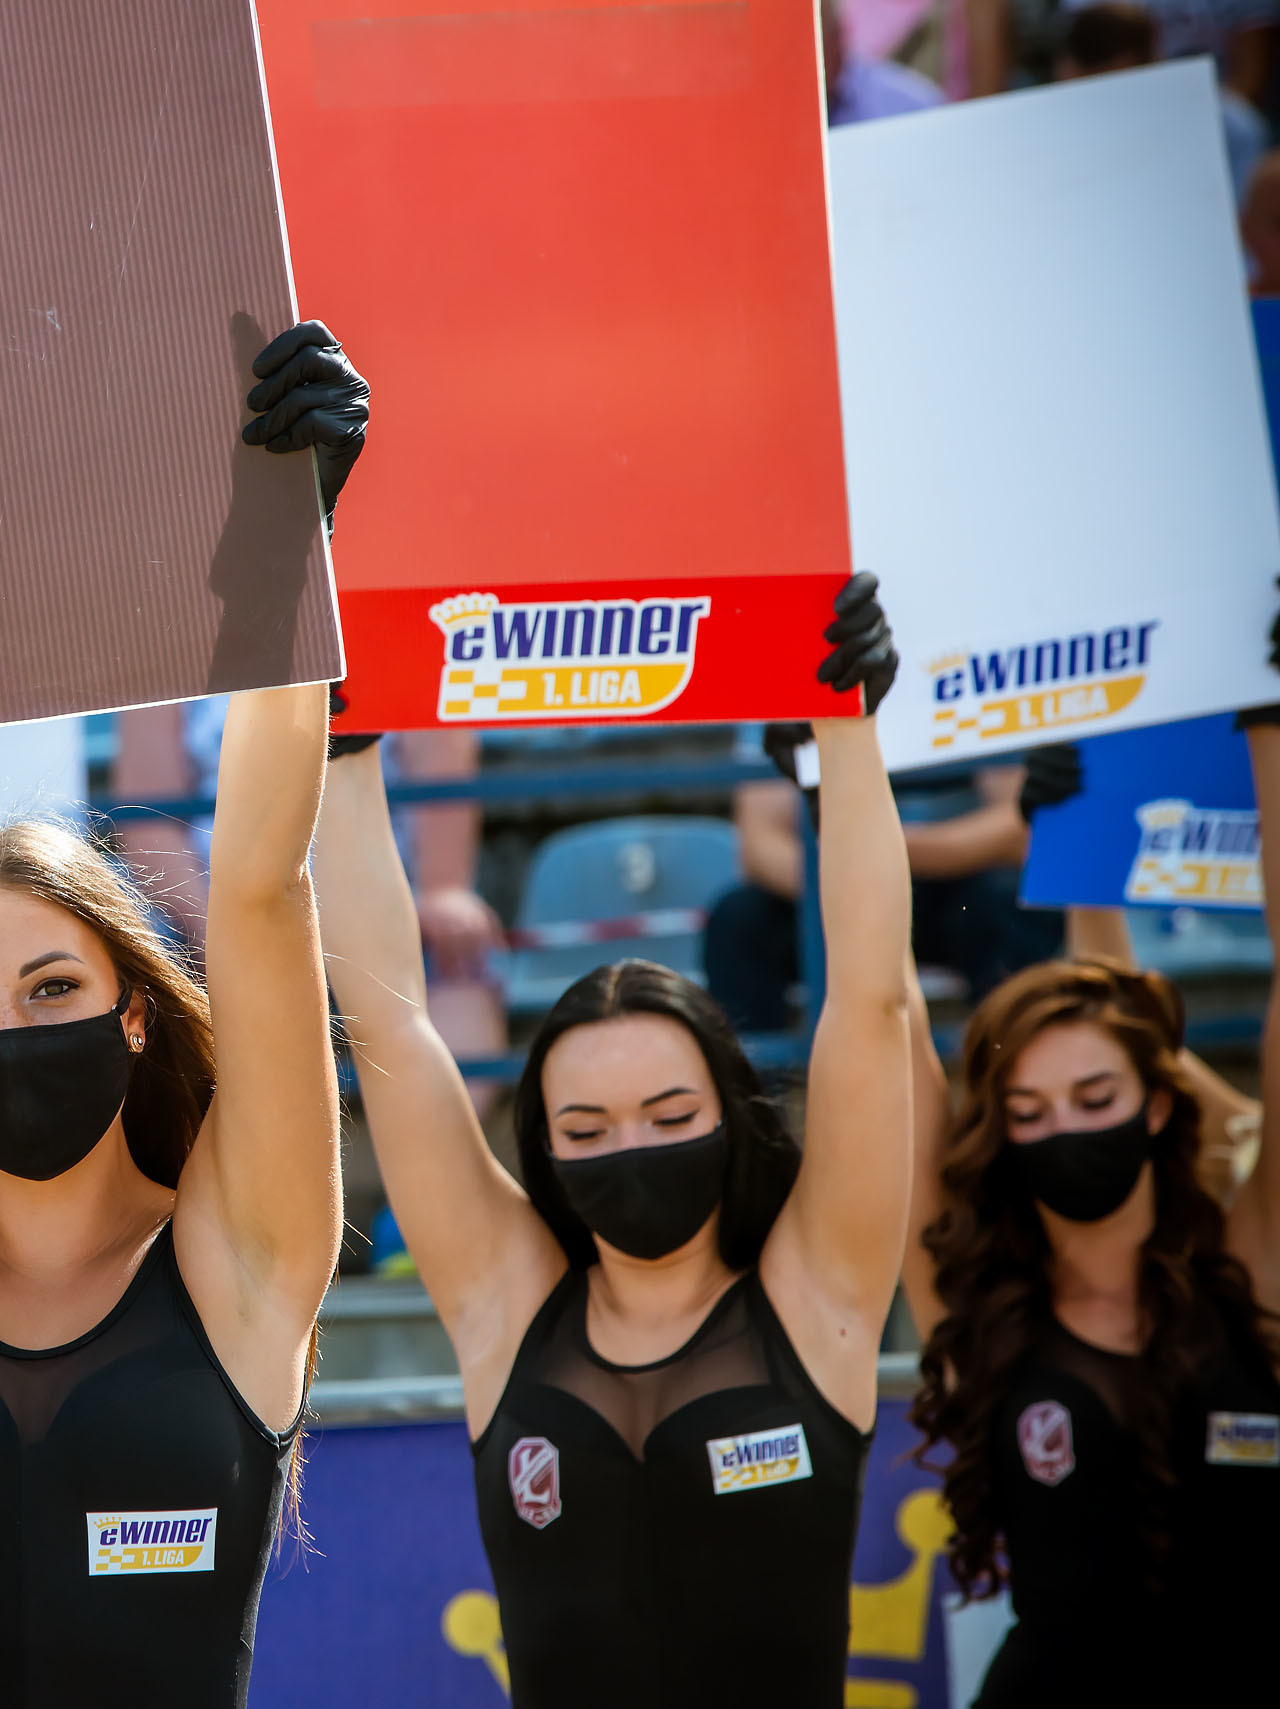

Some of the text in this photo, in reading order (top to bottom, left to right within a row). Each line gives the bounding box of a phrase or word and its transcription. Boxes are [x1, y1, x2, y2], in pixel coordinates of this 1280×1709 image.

[542, 670, 642, 705] 1. LIGA
[142, 1549, 185, 1566] 1. LIGA
